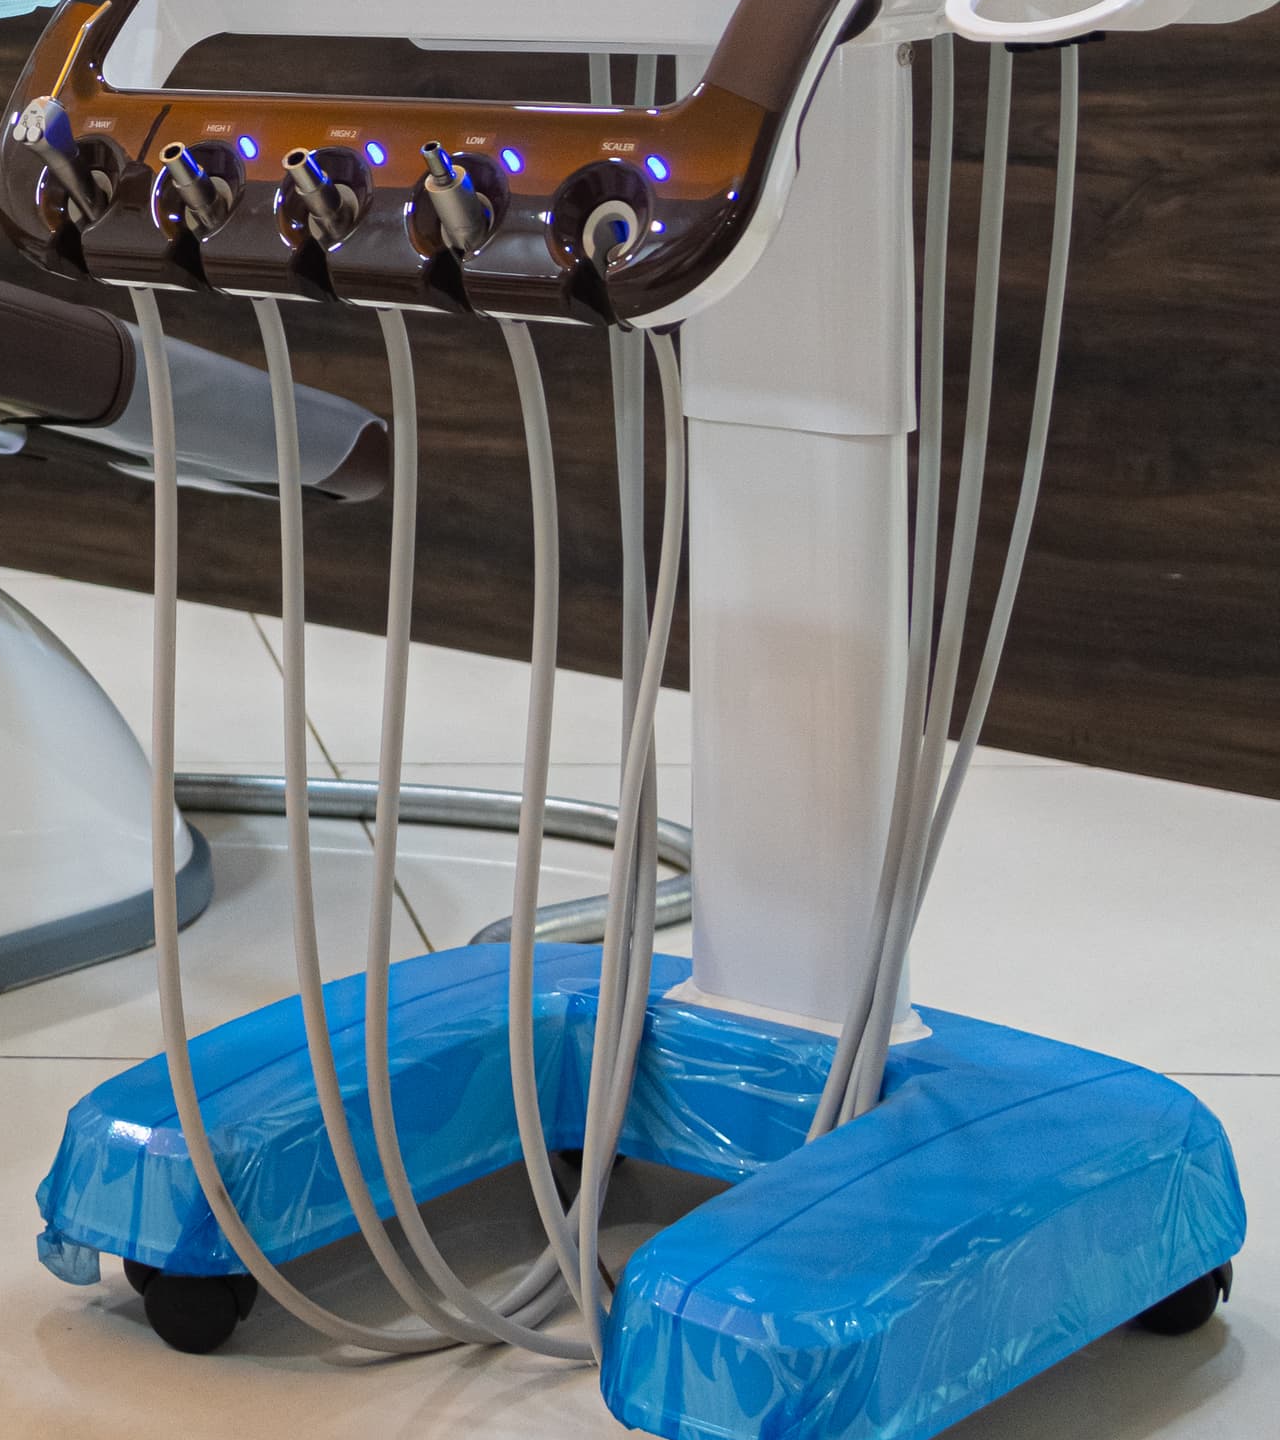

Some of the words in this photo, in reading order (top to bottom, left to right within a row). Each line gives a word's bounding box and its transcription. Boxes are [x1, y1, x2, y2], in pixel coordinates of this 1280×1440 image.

[206, 124, 226, 133] HIGH
[330, 129, 350, 138] HIGH
[466, 136, 487, 145] LOW
[601, 142, 635, 152] SCALER
